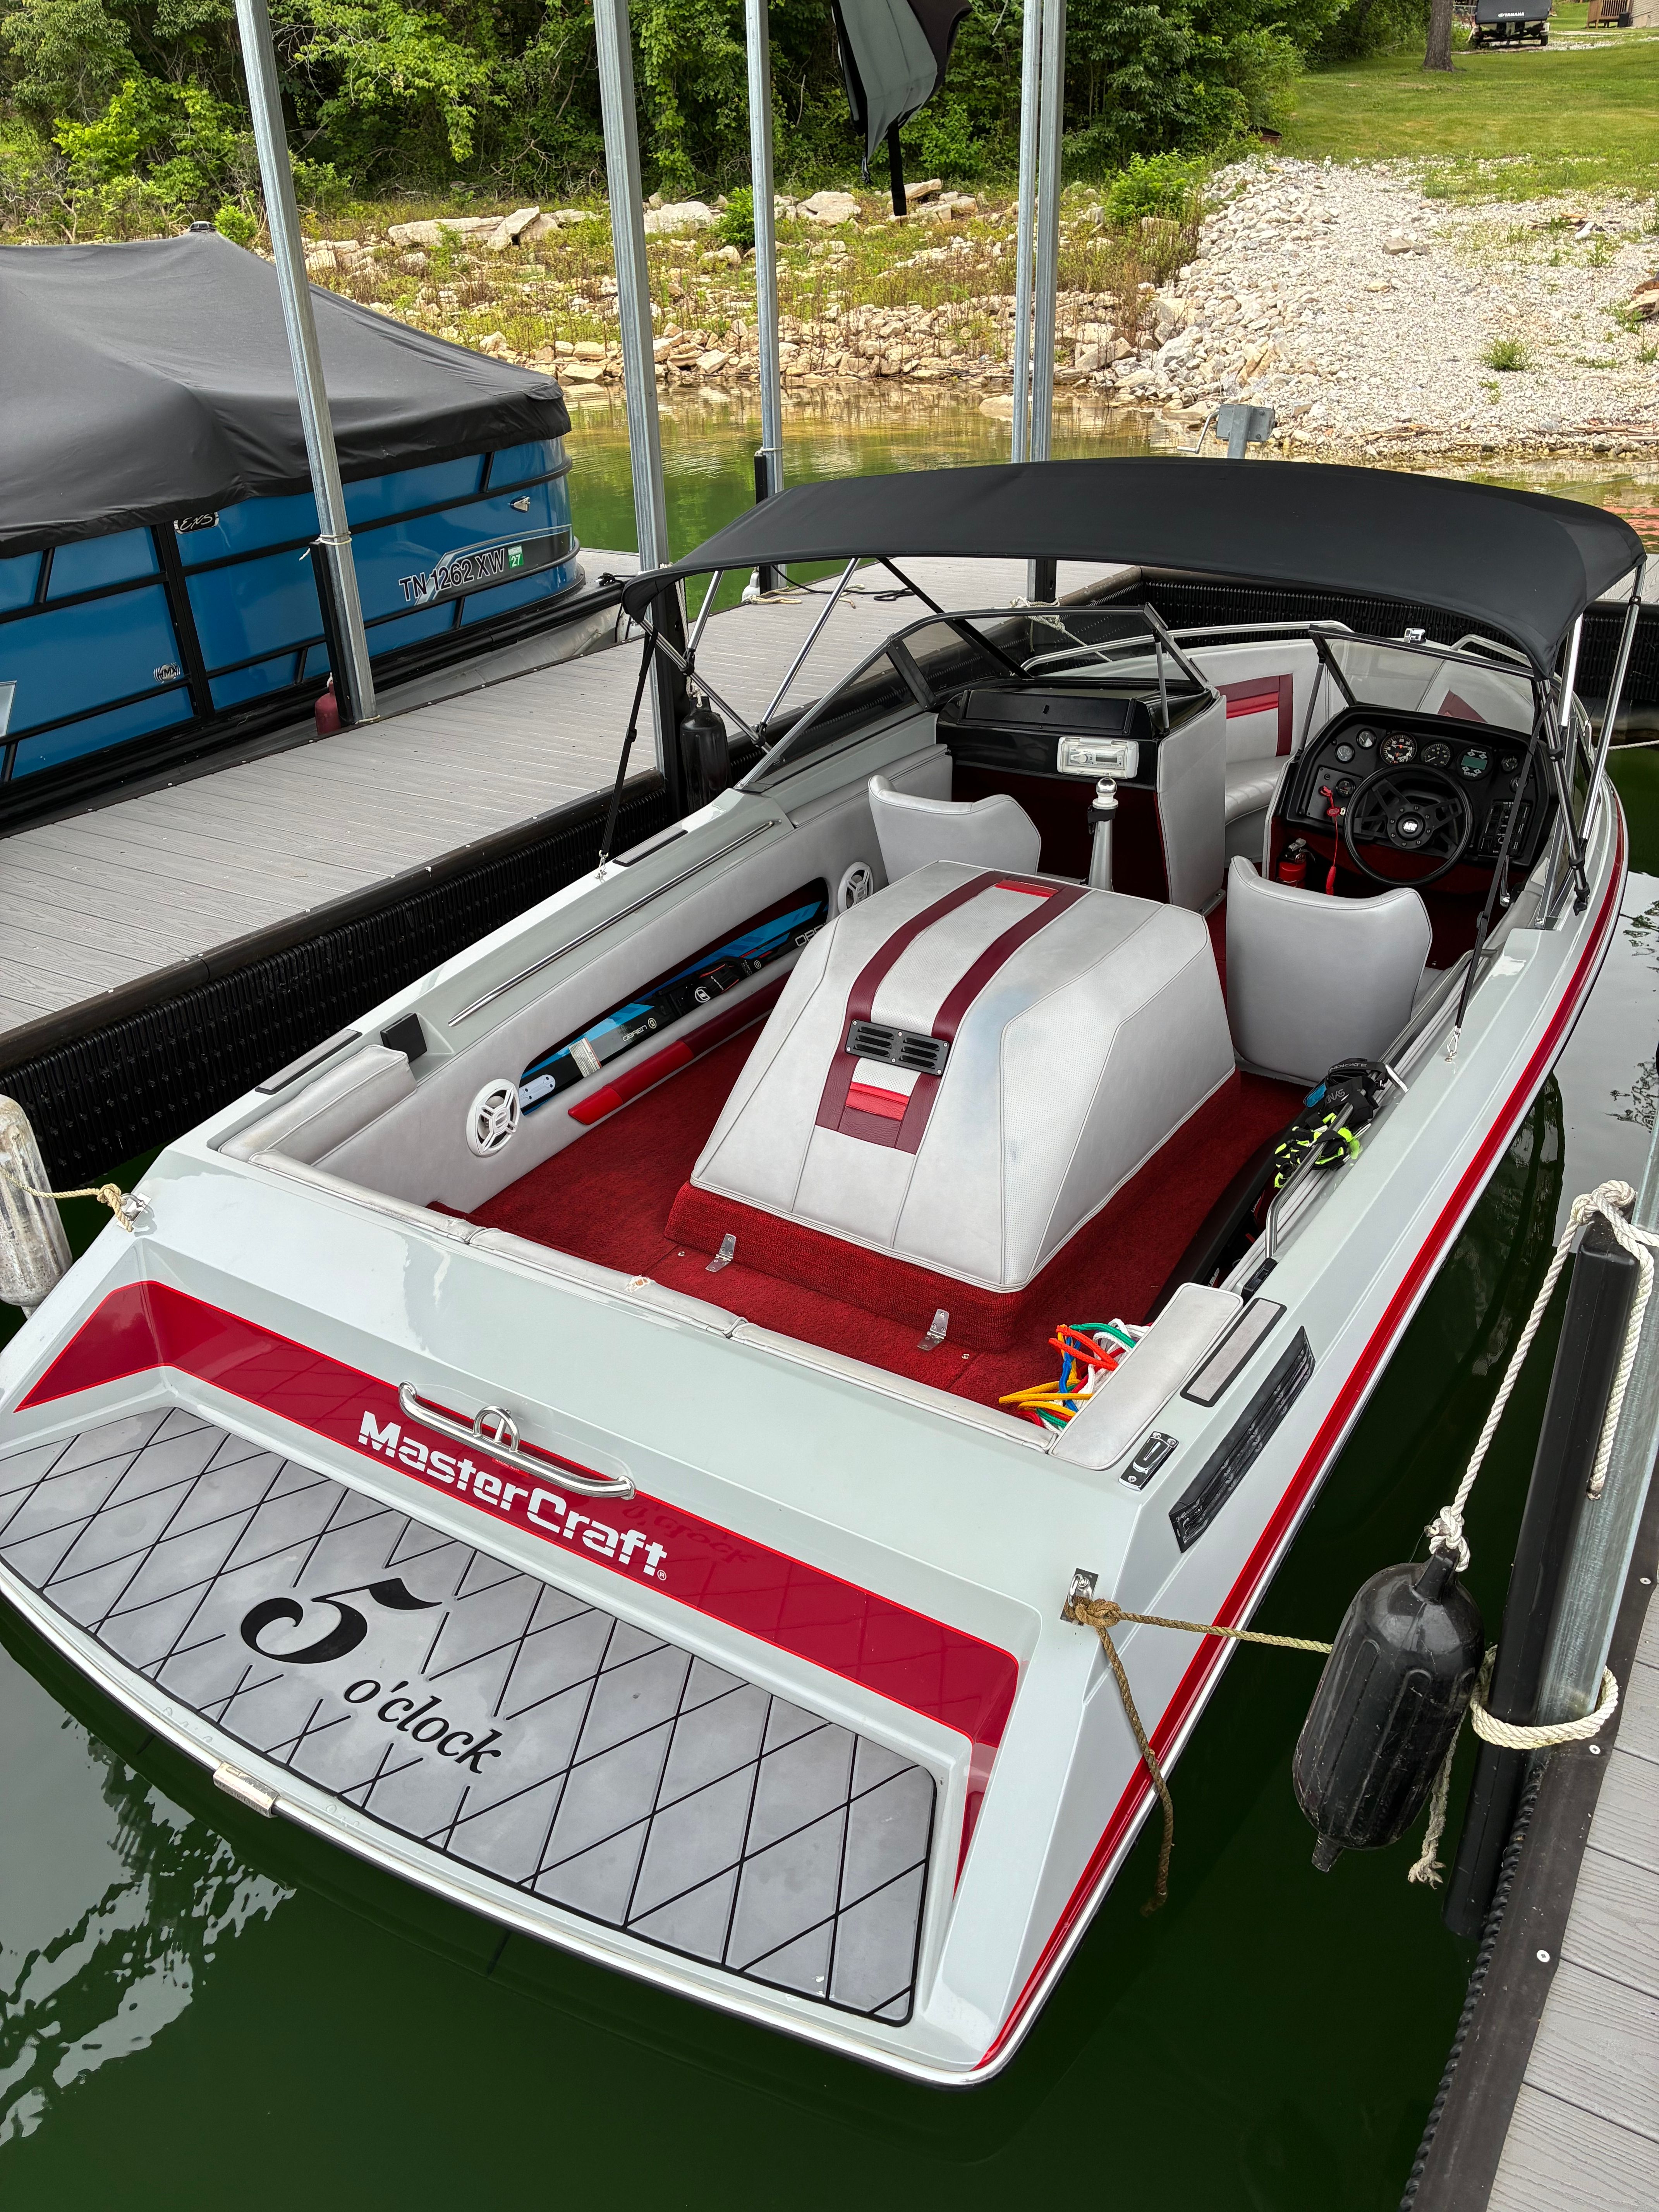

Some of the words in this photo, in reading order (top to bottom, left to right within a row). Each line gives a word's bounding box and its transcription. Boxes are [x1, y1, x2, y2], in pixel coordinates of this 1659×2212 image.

[398, 572, 428, 601] TN
[429, 559, 474, 592] 1262
[474, 548, 505, 580] XW
[510, 554, 521, 567] 27
[357, 1410, 668, 1577] MasterCraft
[240, 1577, 443, 1664] 5
[344, 1679, 502, 1774] o'clock
